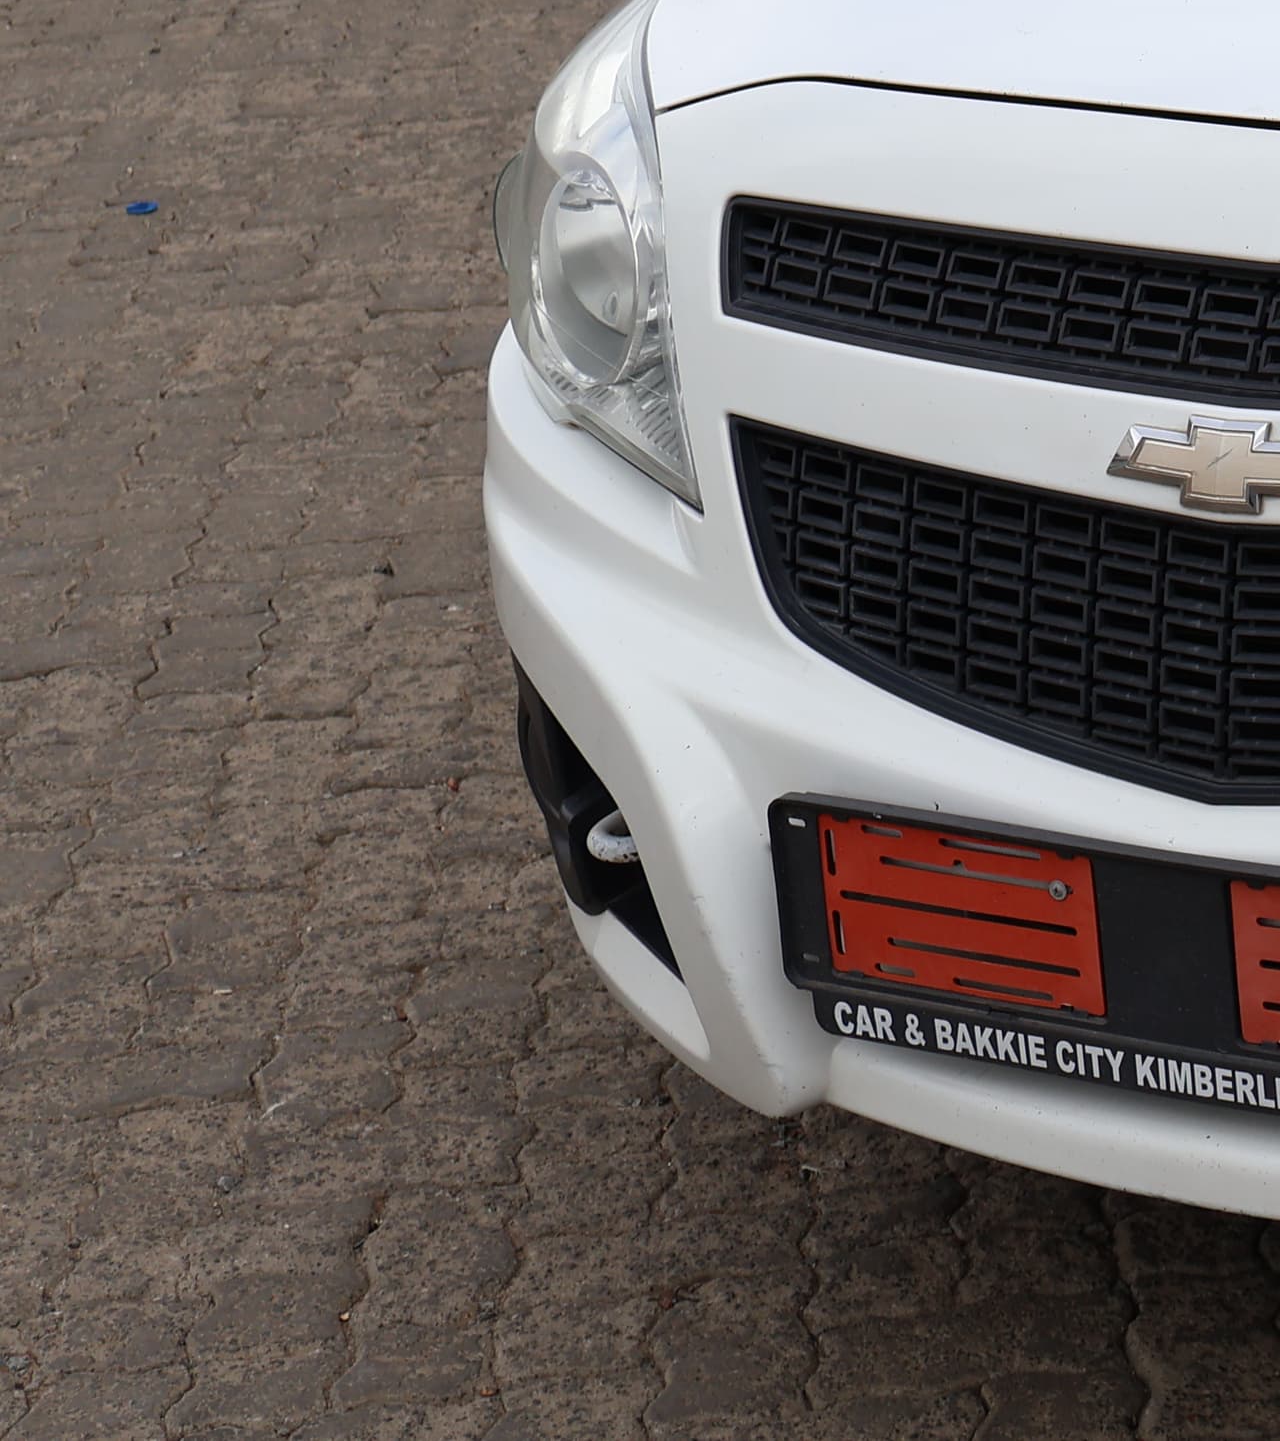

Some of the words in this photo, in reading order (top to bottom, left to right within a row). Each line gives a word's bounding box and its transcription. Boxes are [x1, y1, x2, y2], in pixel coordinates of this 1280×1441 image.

[833, 1001, 897, 1042] CAR
[904, 1012, 926, 1047] &
[934, 1018, 1048, 1069] BAKKIE
[1055, 1040, 1126, 1083] CITY
